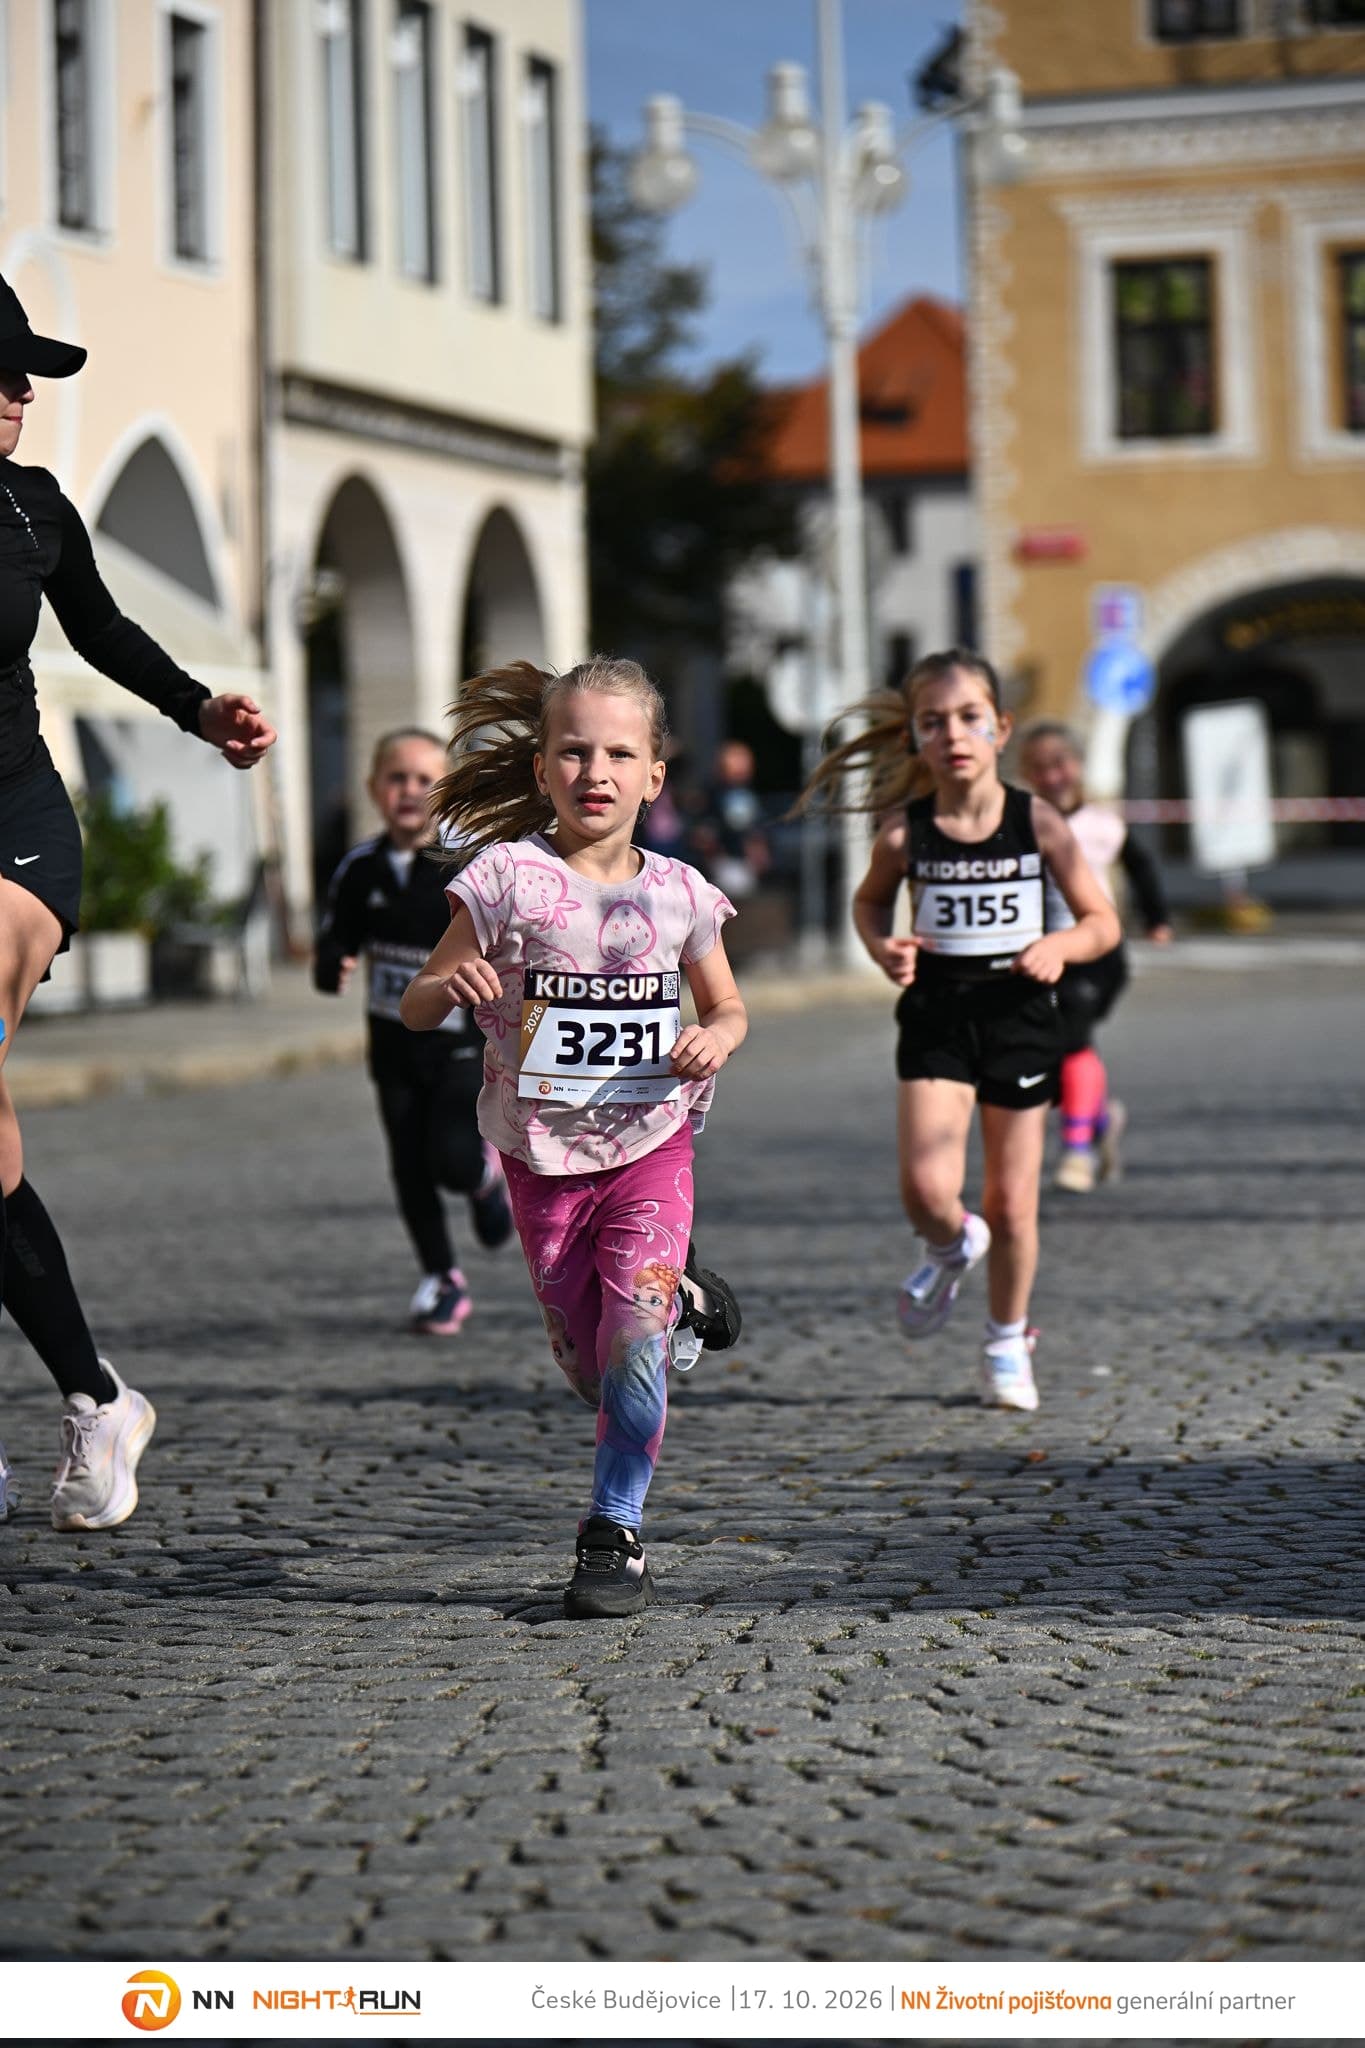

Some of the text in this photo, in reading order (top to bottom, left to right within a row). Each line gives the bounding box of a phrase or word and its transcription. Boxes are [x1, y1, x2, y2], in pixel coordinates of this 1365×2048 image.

[916, 858, 1018, 880] KIDSCUP
[935, 893, 1019, 927] 3155
[535, 974, 659, 1001] KIDSCUP
[523, 1004, 544, 1034] 2026
[555, 1020, 660, 1067] 3231
